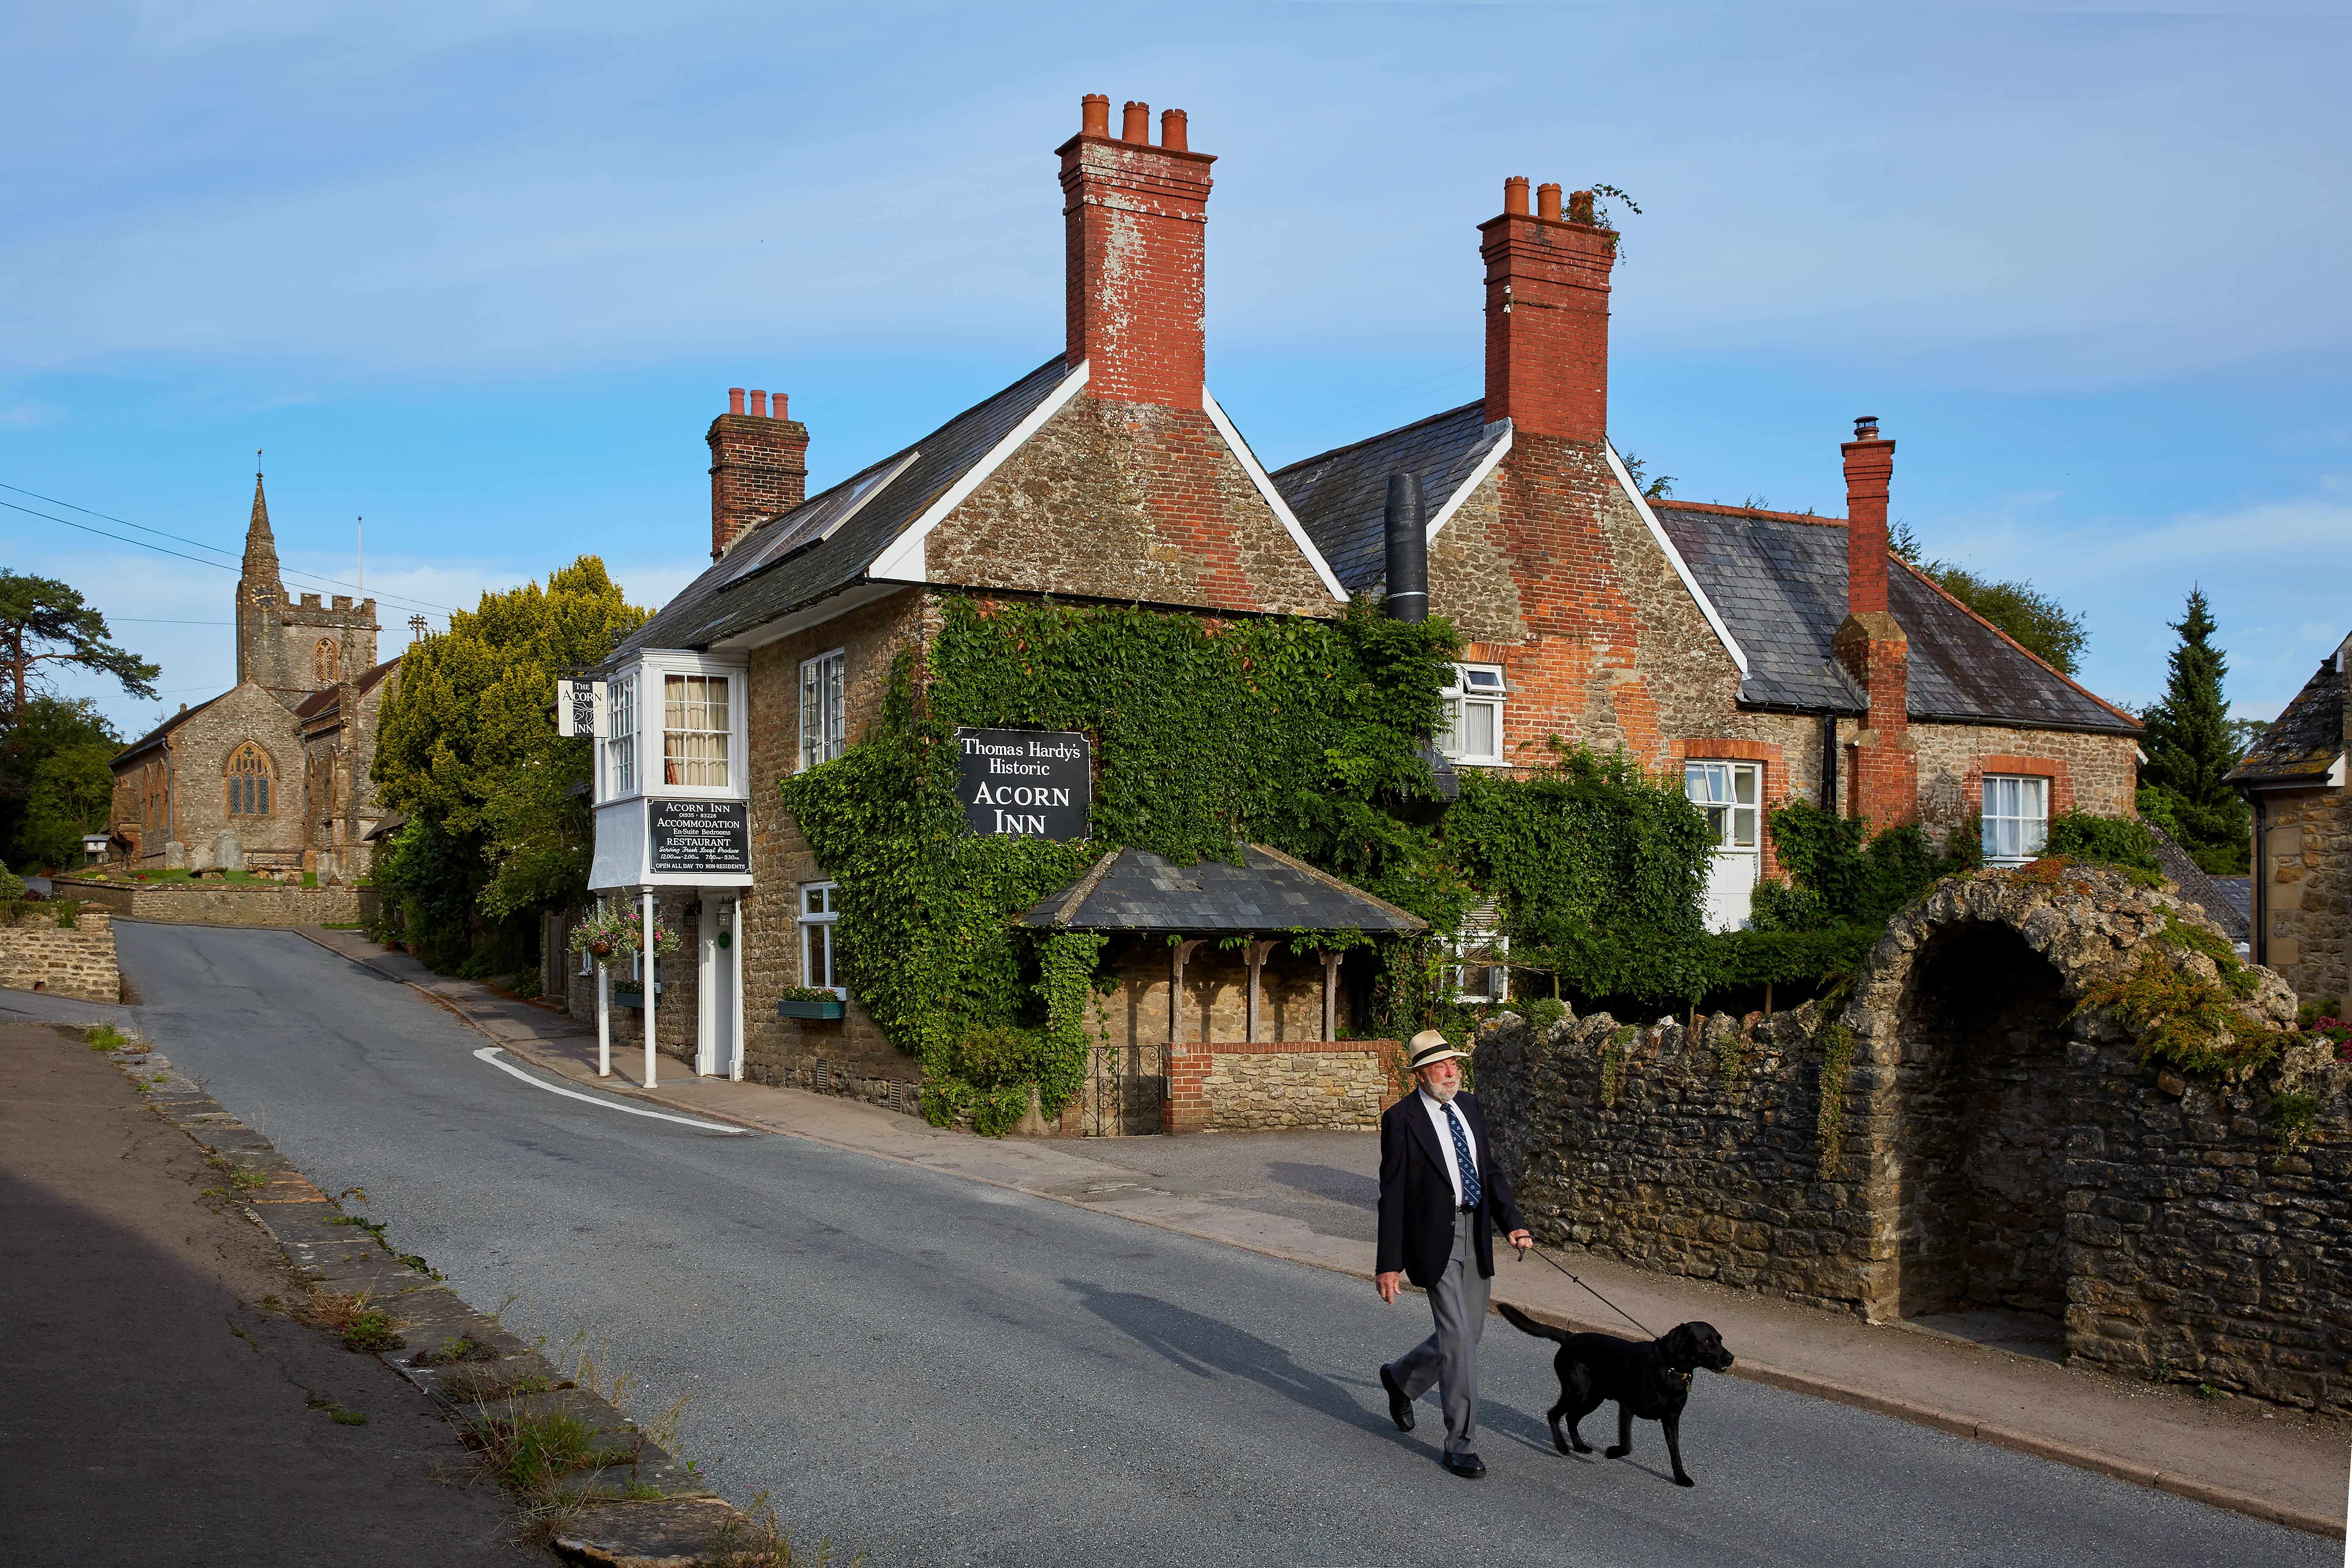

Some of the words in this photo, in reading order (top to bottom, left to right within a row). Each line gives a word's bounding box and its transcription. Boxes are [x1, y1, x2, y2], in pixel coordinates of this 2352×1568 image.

[562, 689, 601, 701] ACORN
[574, 722, 593, 733] INN
[961, 738, 1023, 756] Thomas
[1028, 742, 1080, 762] Hardy's
[989, 758, 1050, 775] Historic
[973, 781, 1070, 806] ACORN
[666, 802, 704, 812] ACORN
[710, 803, 730, 813] INN
[657, 817, 739, 828] ACCOMMODATION
[993, 809, 1046, 834] INN
[667, 838, 731, 846] RESTAURANT
